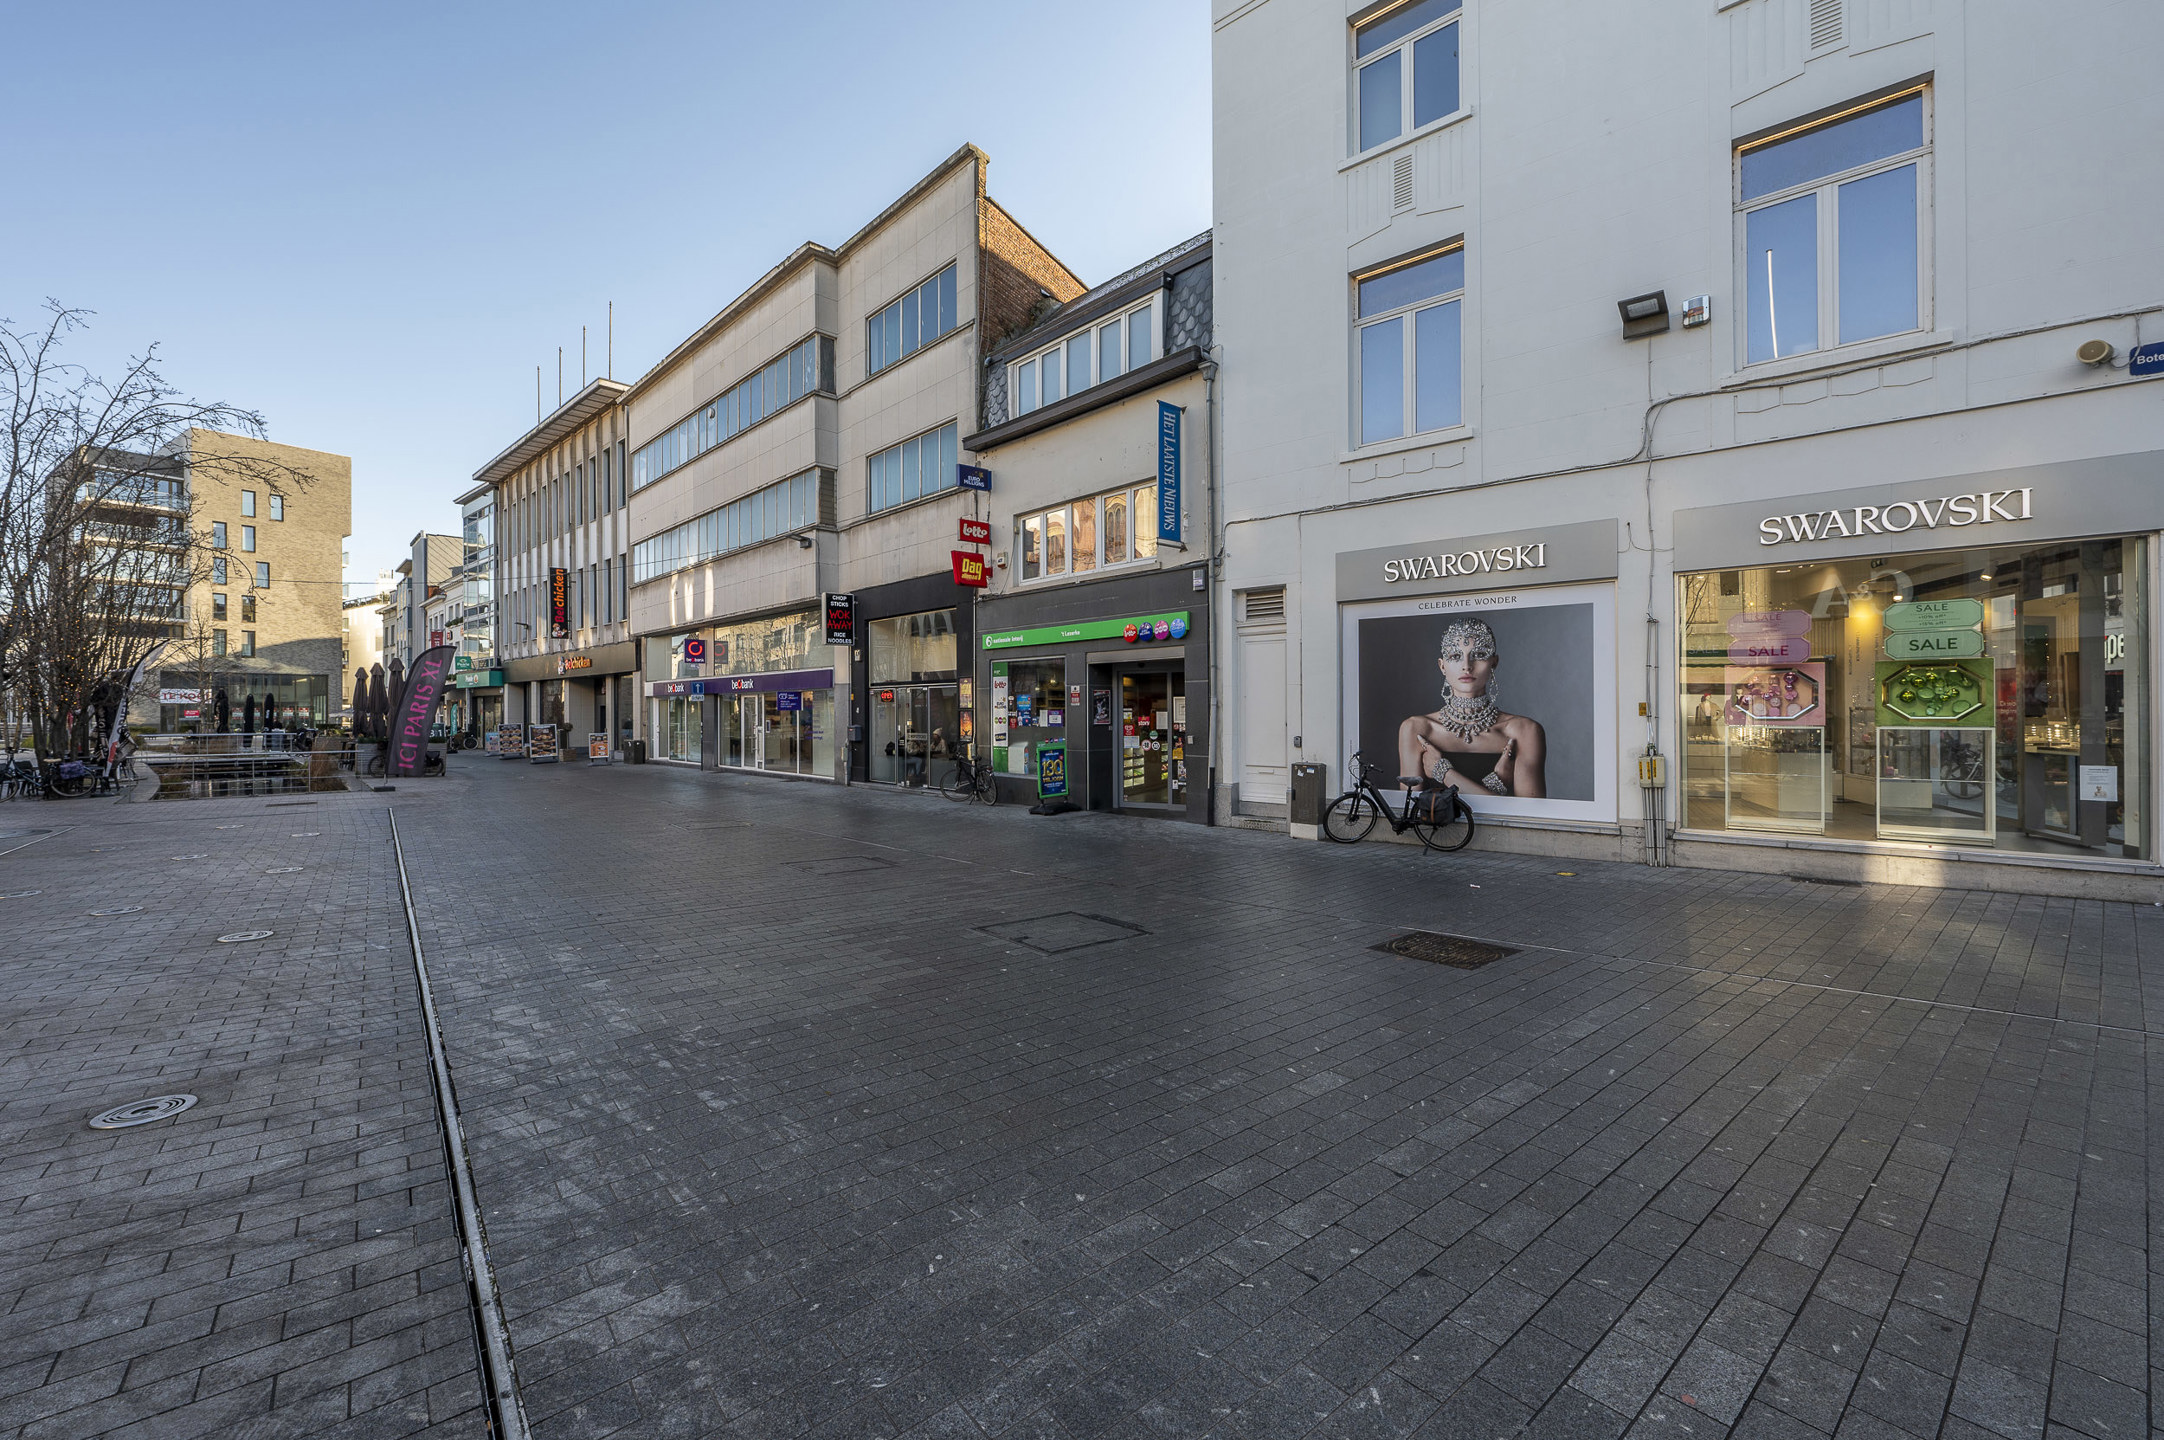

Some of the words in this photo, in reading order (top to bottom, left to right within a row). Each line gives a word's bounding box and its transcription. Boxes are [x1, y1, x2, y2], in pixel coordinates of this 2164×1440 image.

[1163, 411, 1176, 437] HET
[1163, 437, 1176, 486] LAATSTE
[963, 479, 985, 488] MILLIONS
[1163, 487, 1176, 531] NIEUWS
[1760, 487, 2034, 546] SWAROVSKI
[962, 558, 983, 580] Dag
[1384, 543, 1547, 583] SWAROVSKI
[553, 568, 565, 623] Belchicken
[1418, 599, 1471, 610] CELEBRATE
[1474, 595, 1518, 606] WONDER
[828, 609, 850, 620] WOK
[1755, 613, 1782, 621] SALE
[1915, 603, 1949, 612] SALE
[827, 620, 853, 630] AWAY
[1748, 645, 1789, 657] SALE
[1909, 637, 1958, 652] SALE
[421, 659, 442, 680] XL
[404, 683, 434, 737] PARIS
[398, 742, 418, 769] ICI
[1042, 759, 1064, 777] 130
